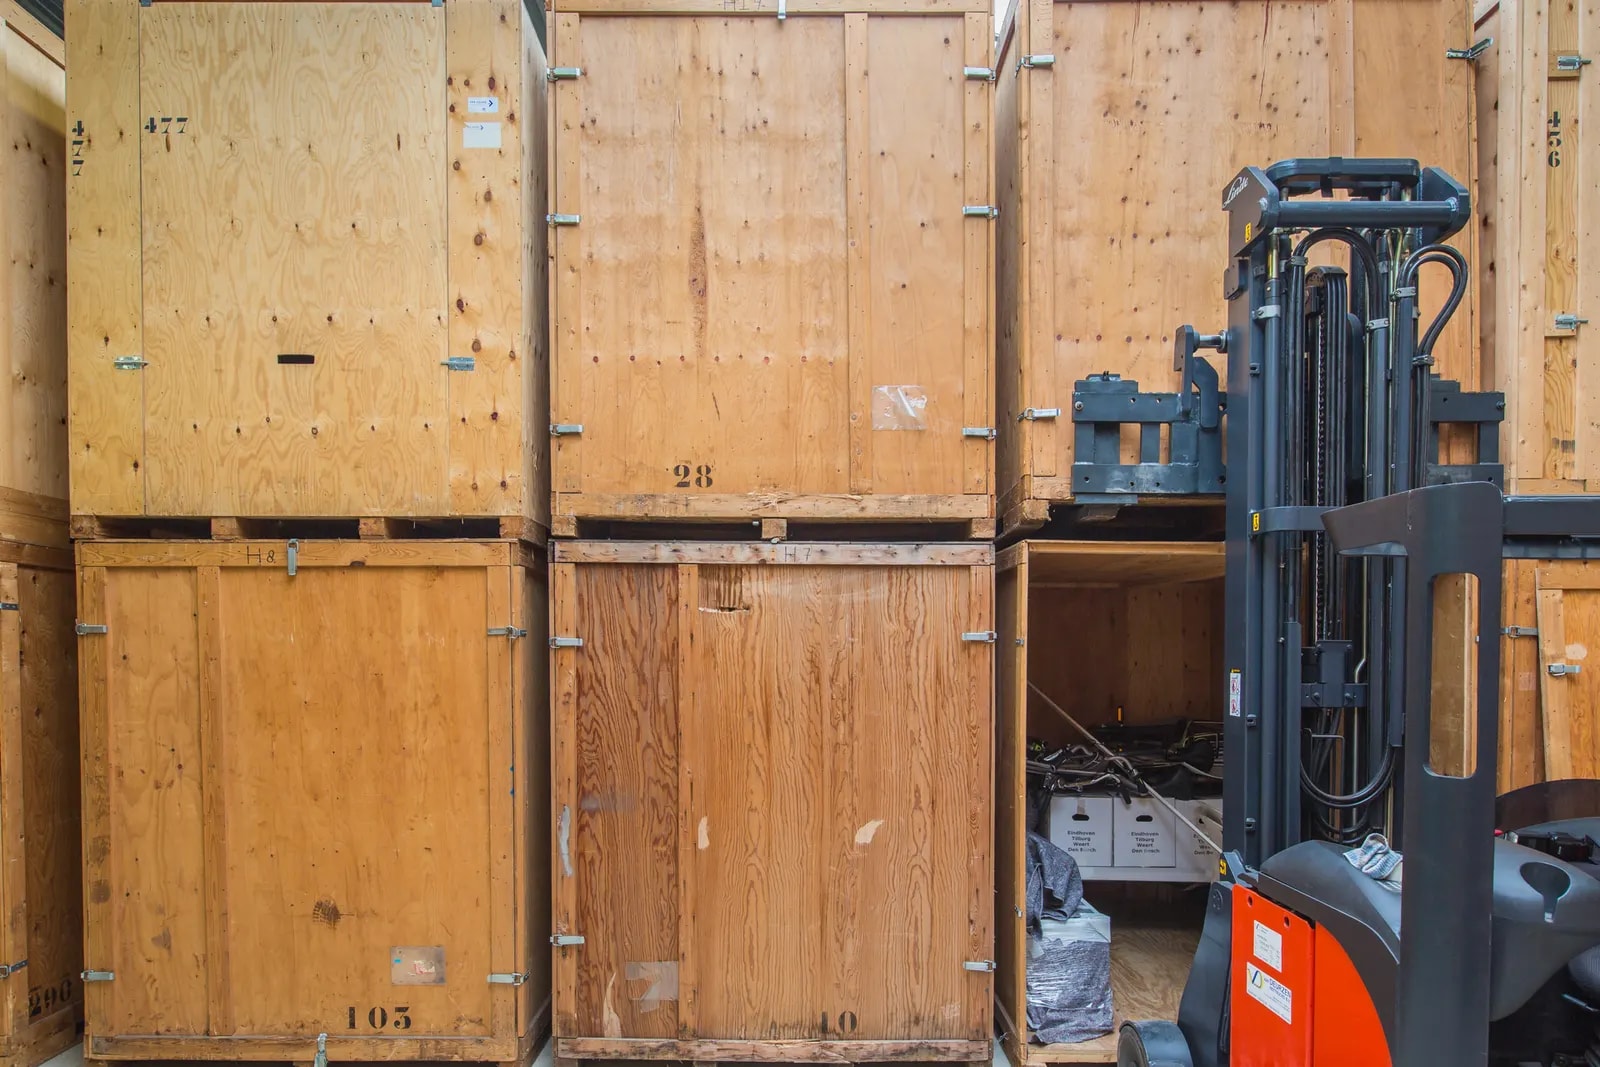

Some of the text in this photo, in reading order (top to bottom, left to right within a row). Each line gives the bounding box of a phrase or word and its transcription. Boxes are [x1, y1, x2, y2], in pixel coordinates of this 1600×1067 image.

[144, 117, 188, 134] 477
[72, 120, 84, 176] 477
[1547, 111, 1561, 168] 456
[1223, 176, 1249, 209] Linde
[673, 464, 713, 488] 28
[246, 545, 275, 564] H8
[347, 1006, 412, 1029] 103
[821, 1010, 858, 1034] 10
